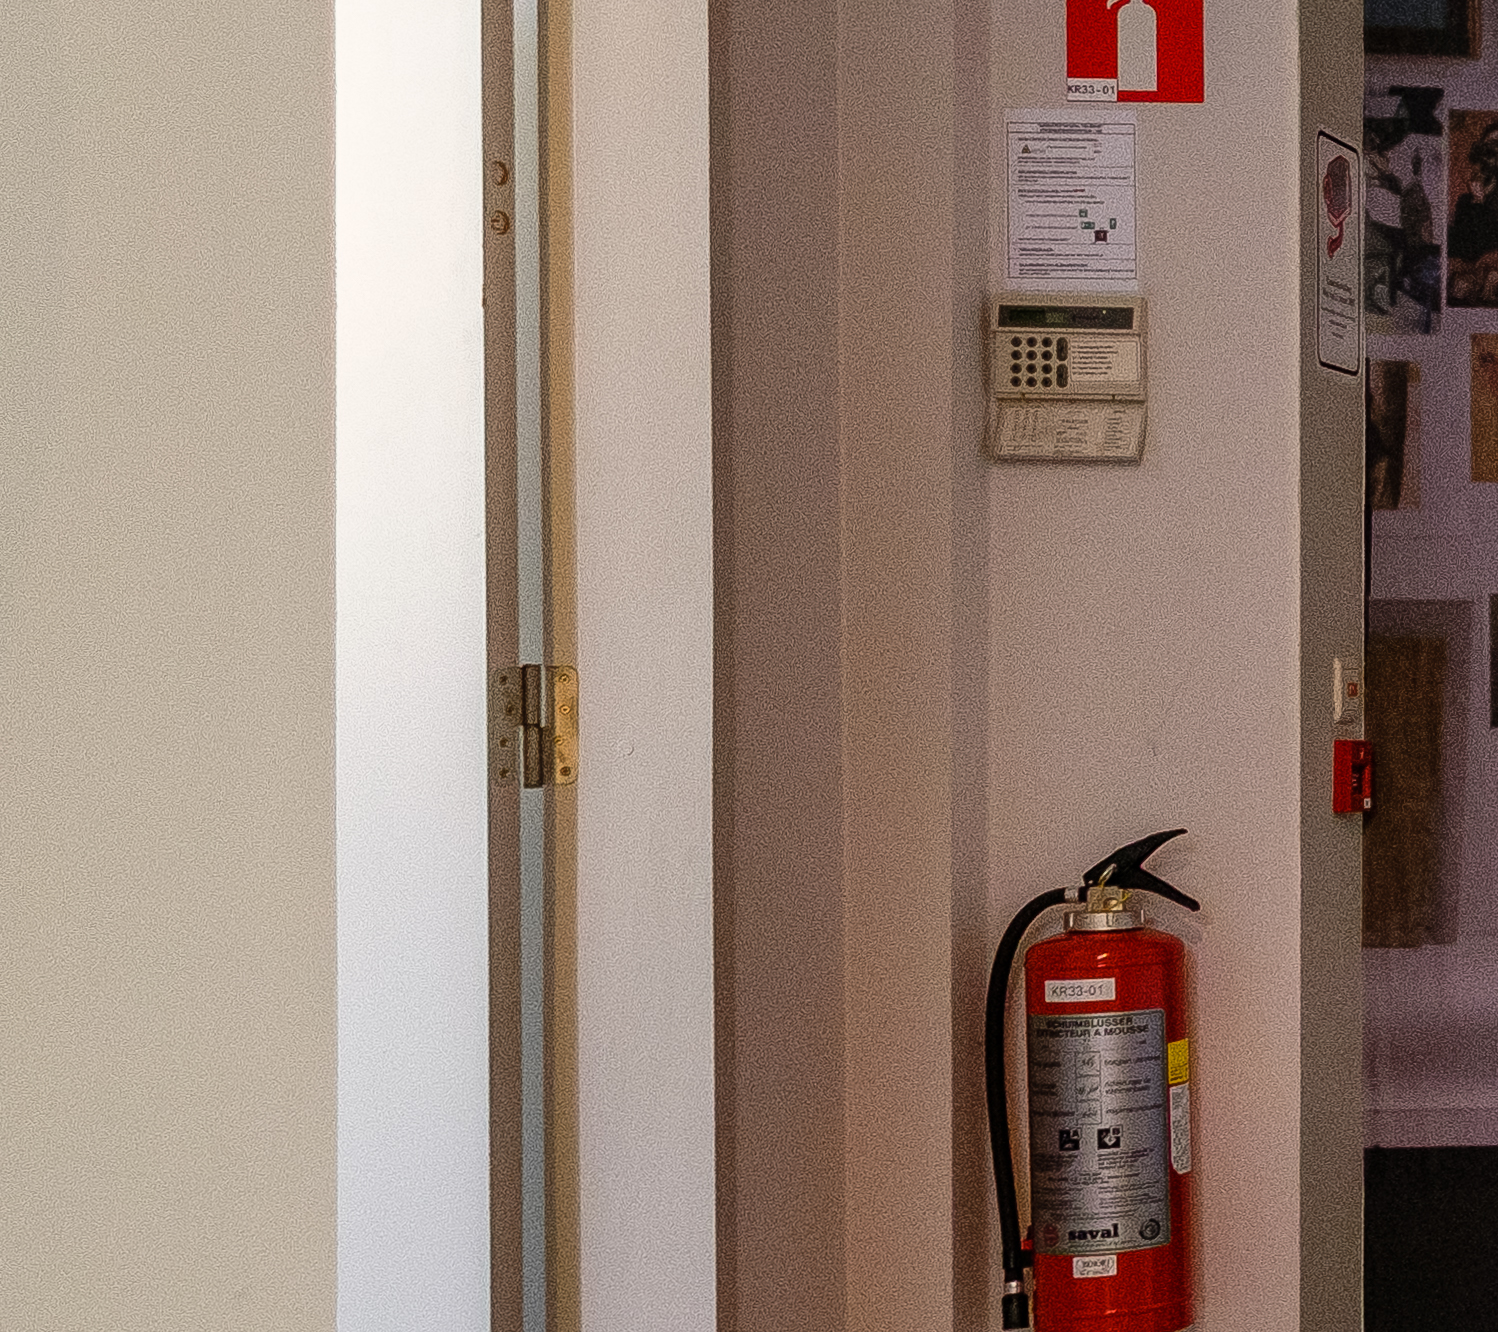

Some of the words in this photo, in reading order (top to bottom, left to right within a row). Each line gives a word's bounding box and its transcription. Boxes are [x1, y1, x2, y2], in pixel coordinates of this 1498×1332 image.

[1067, 84, 1115, 95] KR33-01
[1051, 984, 1104, 997] KR33-01
[1068, 1223, 1119, 1241] saval
